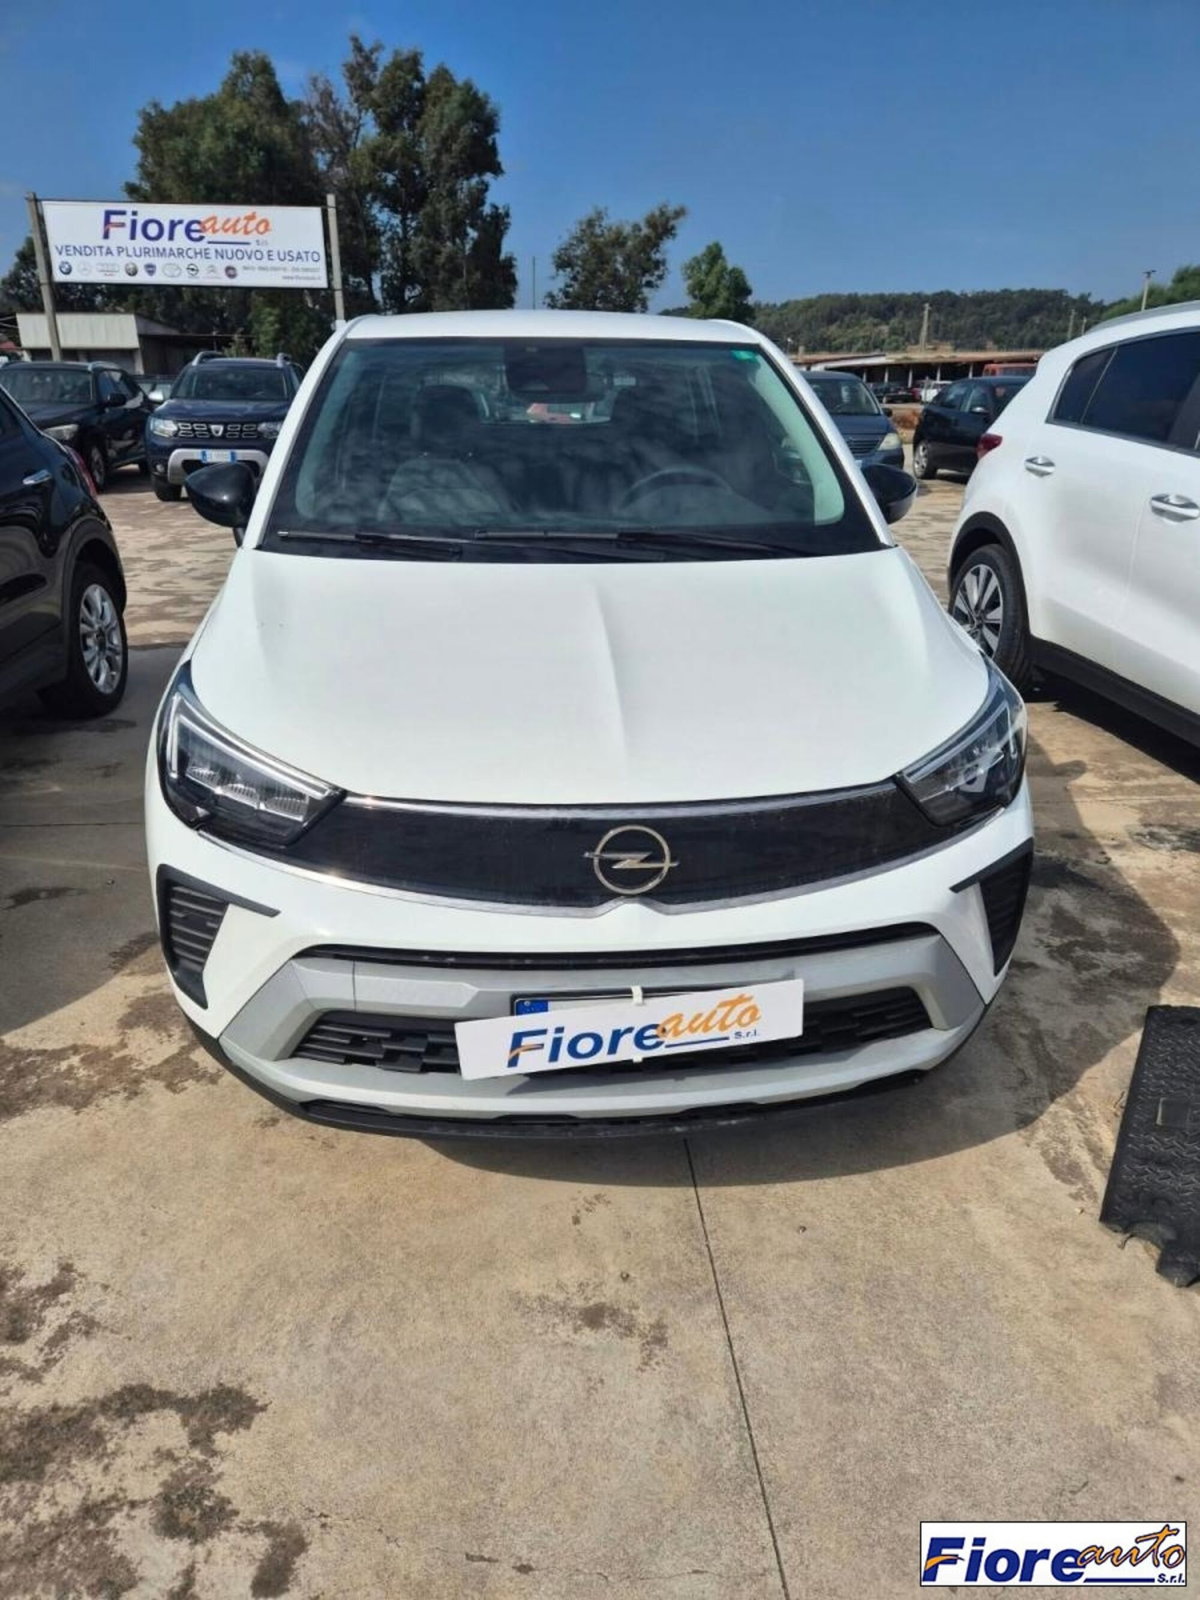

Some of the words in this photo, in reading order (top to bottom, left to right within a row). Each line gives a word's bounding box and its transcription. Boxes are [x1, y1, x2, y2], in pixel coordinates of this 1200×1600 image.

[55, 244, 114, 257] VENDITA
[117, 246, 212, 260] PLURIMARCHE
[214, 249, 264, 261] NUOVO
[267, 250, 275, 261] E
[277, 250, 321, 262] USATO
[733, 1029, 761, 1040] S.r.l.
